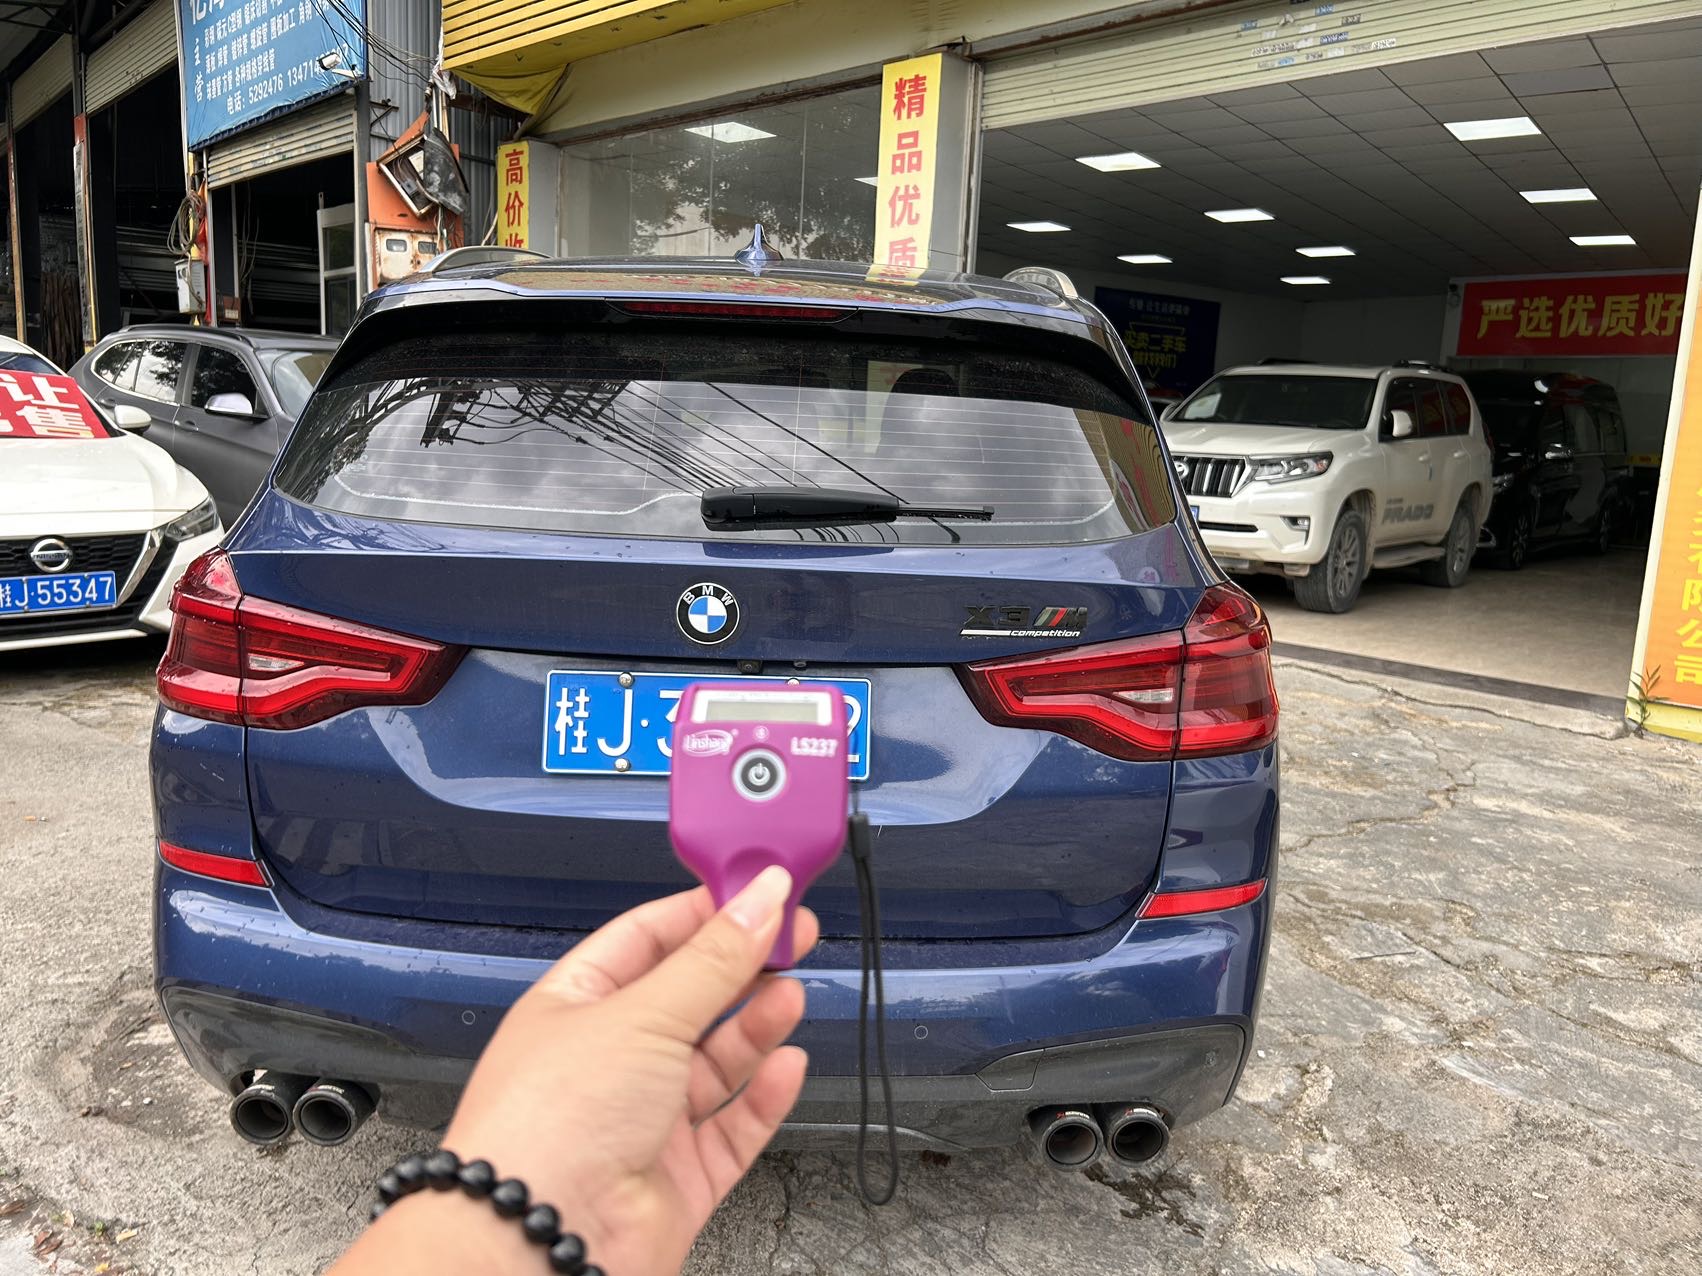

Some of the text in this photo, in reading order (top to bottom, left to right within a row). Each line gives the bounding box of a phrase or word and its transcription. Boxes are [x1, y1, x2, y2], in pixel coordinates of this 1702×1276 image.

[248, 72, 284, 105] 5292476
[887, 74, 927, 267] 精品优质
[1476, 292, 1684, 340] 严选优质好
[0, 405, 95, 438] 售
[682, 585, 734, 606] BMW
[1011, 629, 1081, 638] competition
[554, 687, 862, 764] 桂J·32
